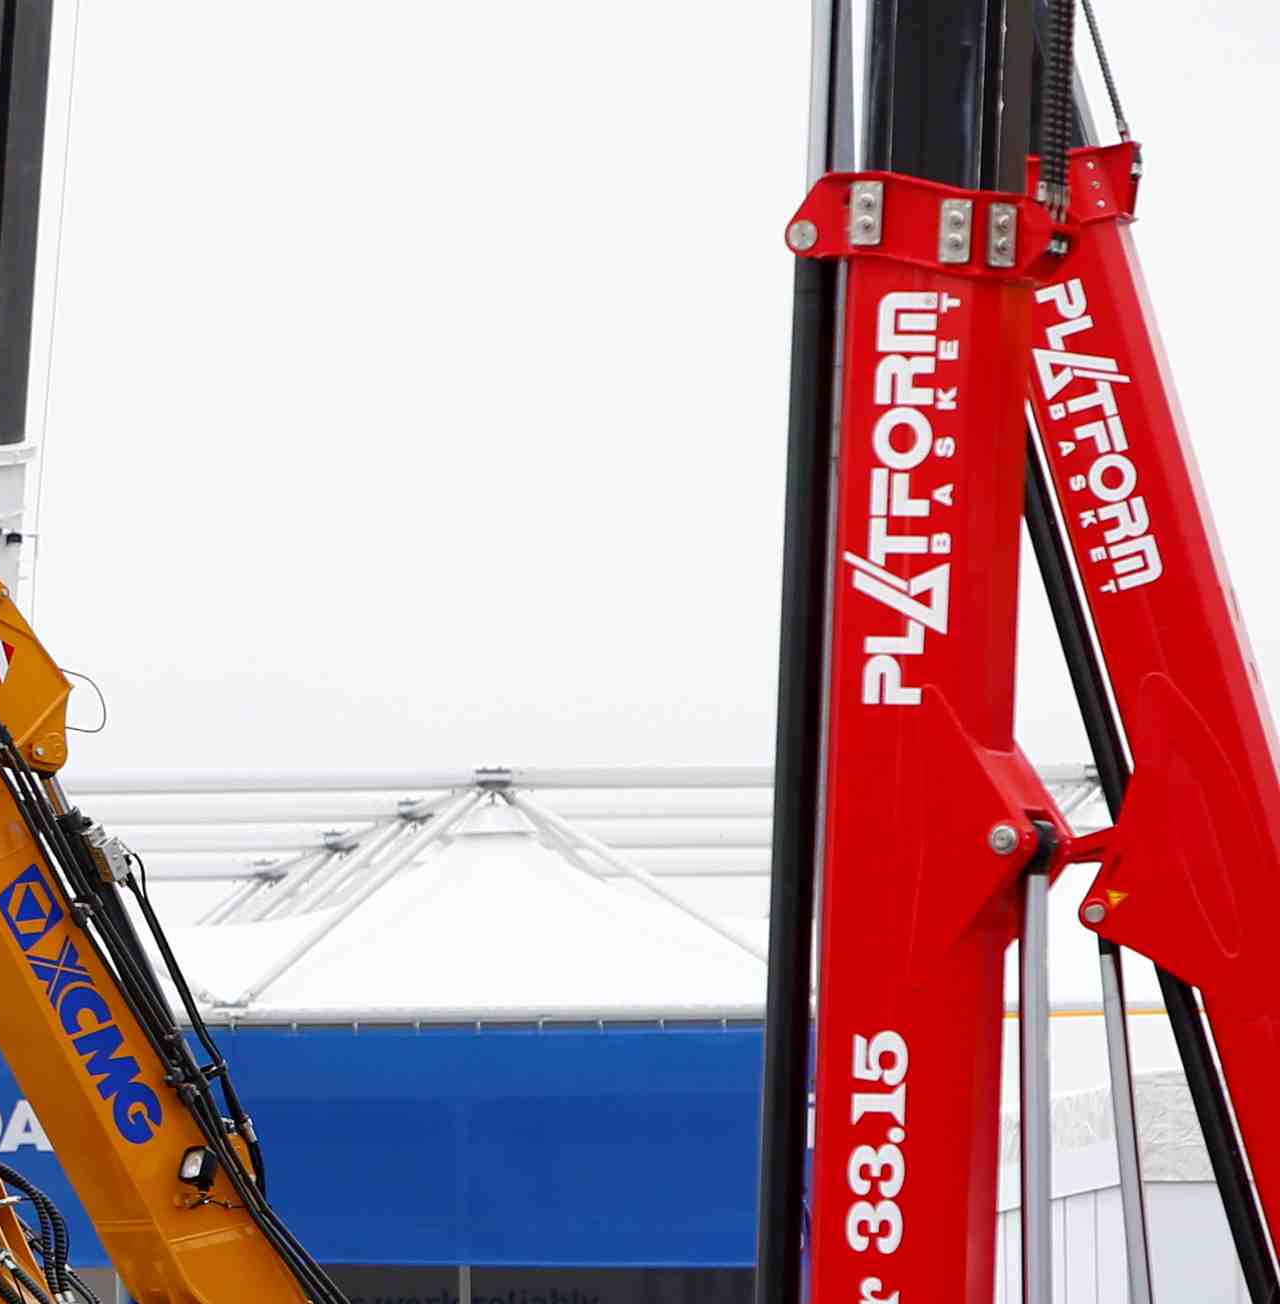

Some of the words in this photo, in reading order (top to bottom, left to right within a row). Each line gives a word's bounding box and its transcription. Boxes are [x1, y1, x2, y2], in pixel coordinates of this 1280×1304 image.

[844, 291, 951, 705] PLATFORM
[931, 293, 961, 554] BASKET
[1032, 278, 1163, 591] PLATFORM
[1048, 404, 1118, 593] BASKET
[25, 934, 162, 1145] XCMG
[846, 1030, 909, 1255] 33.15
